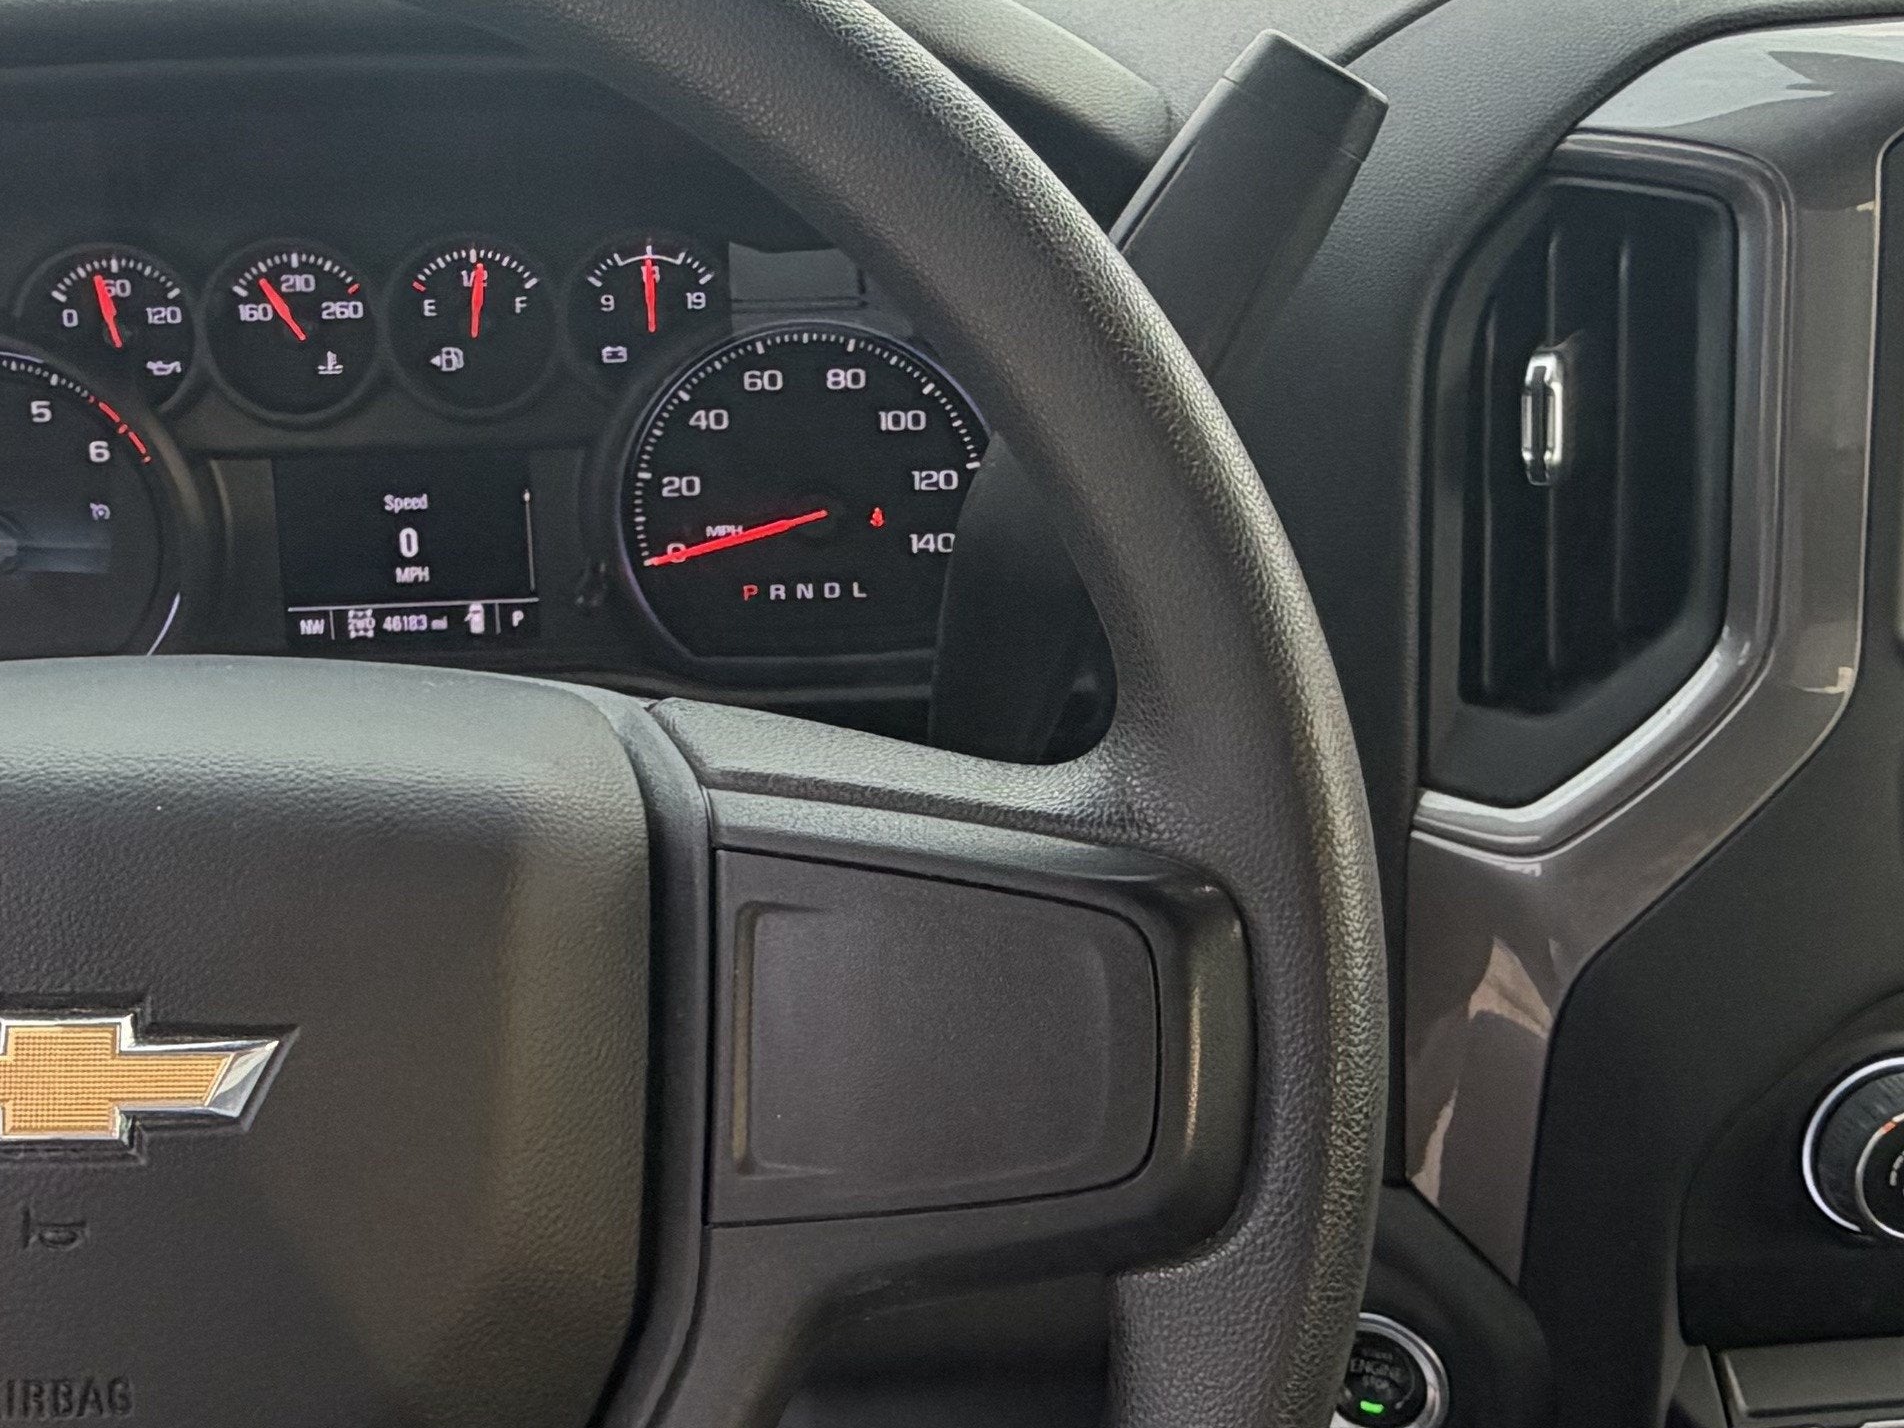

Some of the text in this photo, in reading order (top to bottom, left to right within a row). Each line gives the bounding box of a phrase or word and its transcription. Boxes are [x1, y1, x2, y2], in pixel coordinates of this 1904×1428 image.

[280, 273, 315, 293] 210
[321, 300, 364, 320] 260
[424, 299, 438, 317] E
[514, 296, 529, 314] F
[600, 294, 616, 312] 9
[686, 292, 708, 310] 19
[62, 309, 79, 328] 0
[146, 306, 182, 324] 120
[238, 302, 274, 322] 160
[742, 369, 784, 391] 60
[826, 368, 866, 390] 80
[30, 401, 53, 423] 5
[688, 409, 730, 431] 40
[878, 410, 927, 432] 100
[89, 442, 110, 463] 6
[661, 476, 702, 498] 20
[911, 470, 959, 492] 120
[383, 493, 429, 513] Speed
[399, 526, 419, 559] 0
[909, 532, 956, 555] 140
[395, 565, 431, 584] MPH
[743, 582, 867, 601] P R N D L
[512, 610, 525, 627] P
